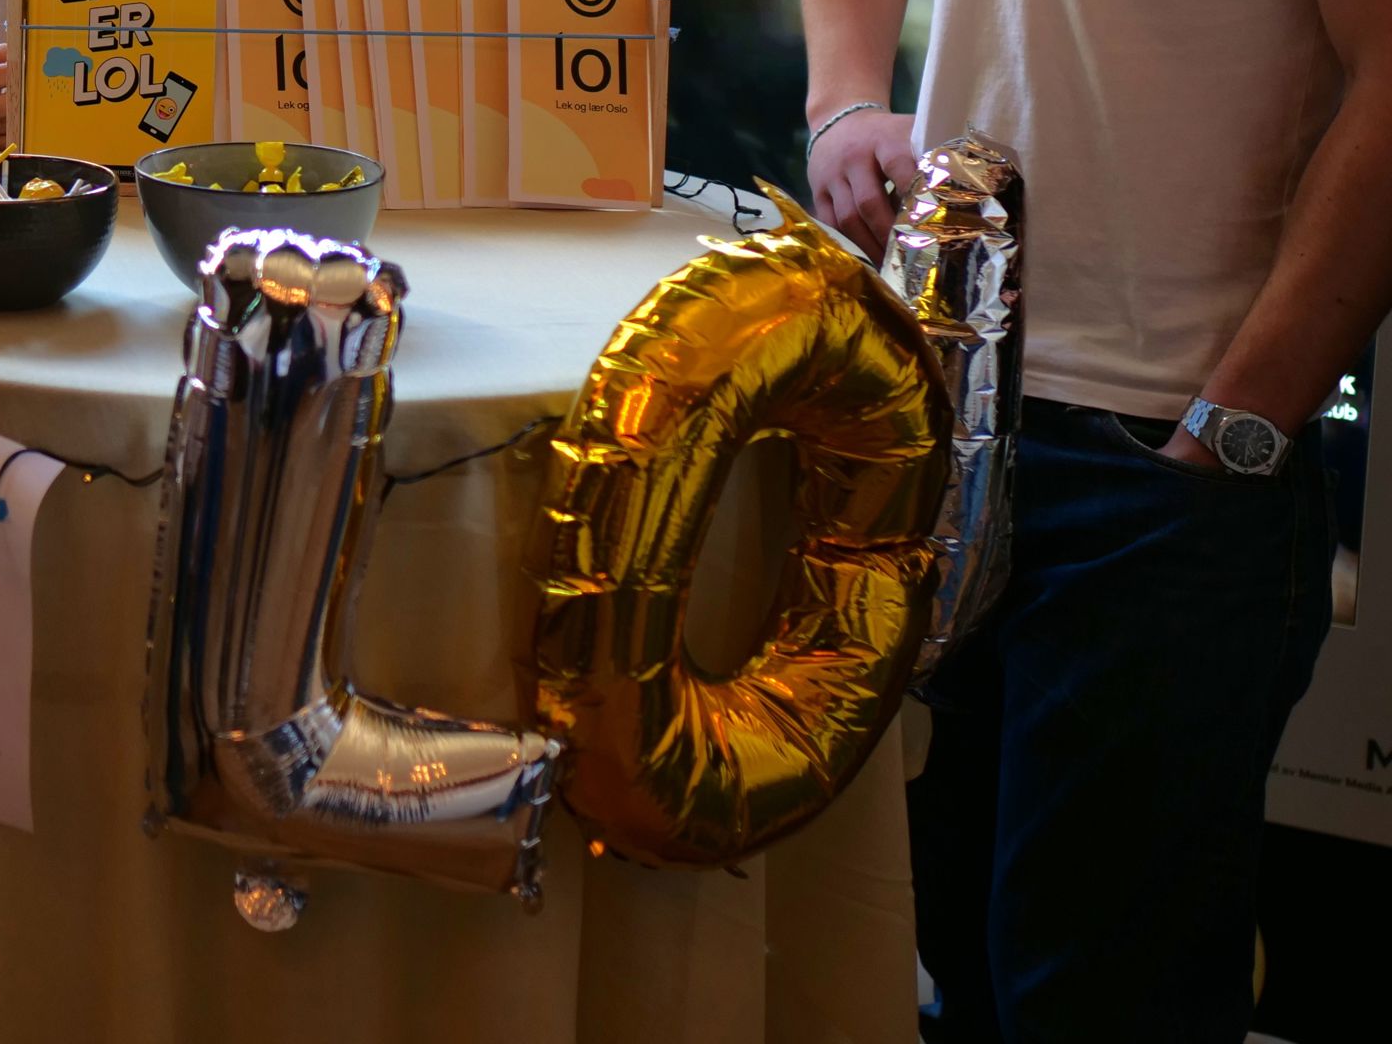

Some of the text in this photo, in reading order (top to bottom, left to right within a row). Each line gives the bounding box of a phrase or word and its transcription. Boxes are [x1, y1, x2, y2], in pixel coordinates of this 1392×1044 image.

[88, 2, 154, 52] ER
[73, 54, 167, 106] LOL
[554, 32, 628, 96] lol
[277, 100, 295, 110] Lek
[555, 100, 628, 114] Lek og lær Oslo
